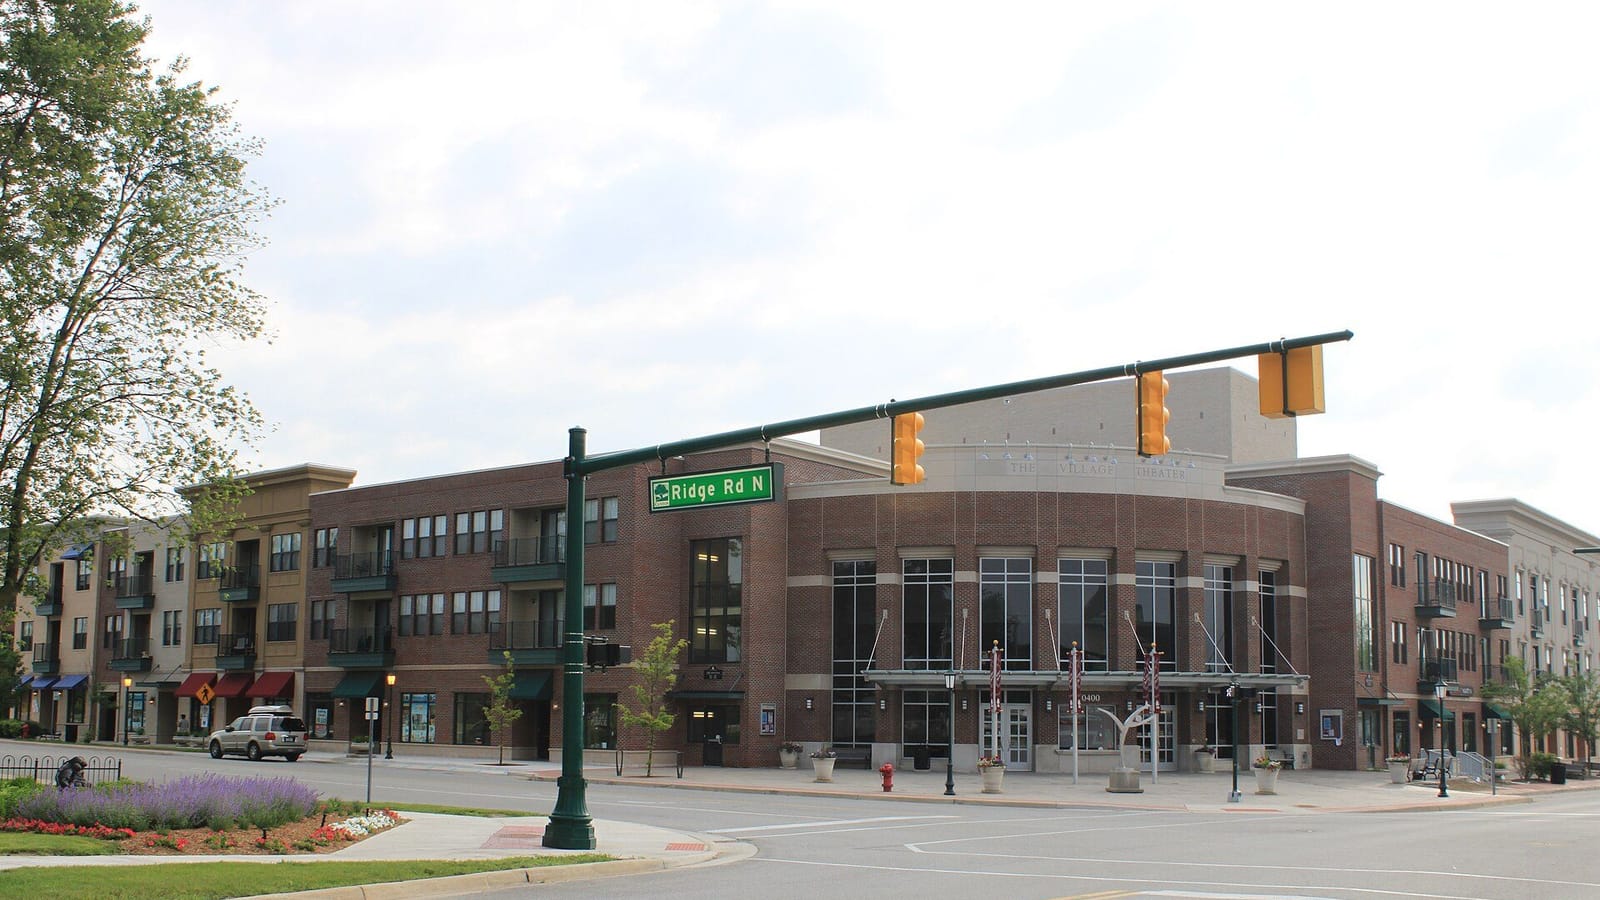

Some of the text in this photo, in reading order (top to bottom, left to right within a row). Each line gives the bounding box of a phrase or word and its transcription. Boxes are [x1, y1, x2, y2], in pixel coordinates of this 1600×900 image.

[1011, 463, 1185, 480] THE VILLAGE THEATER
[672, 475, 763, 502] Ridge Rd N
